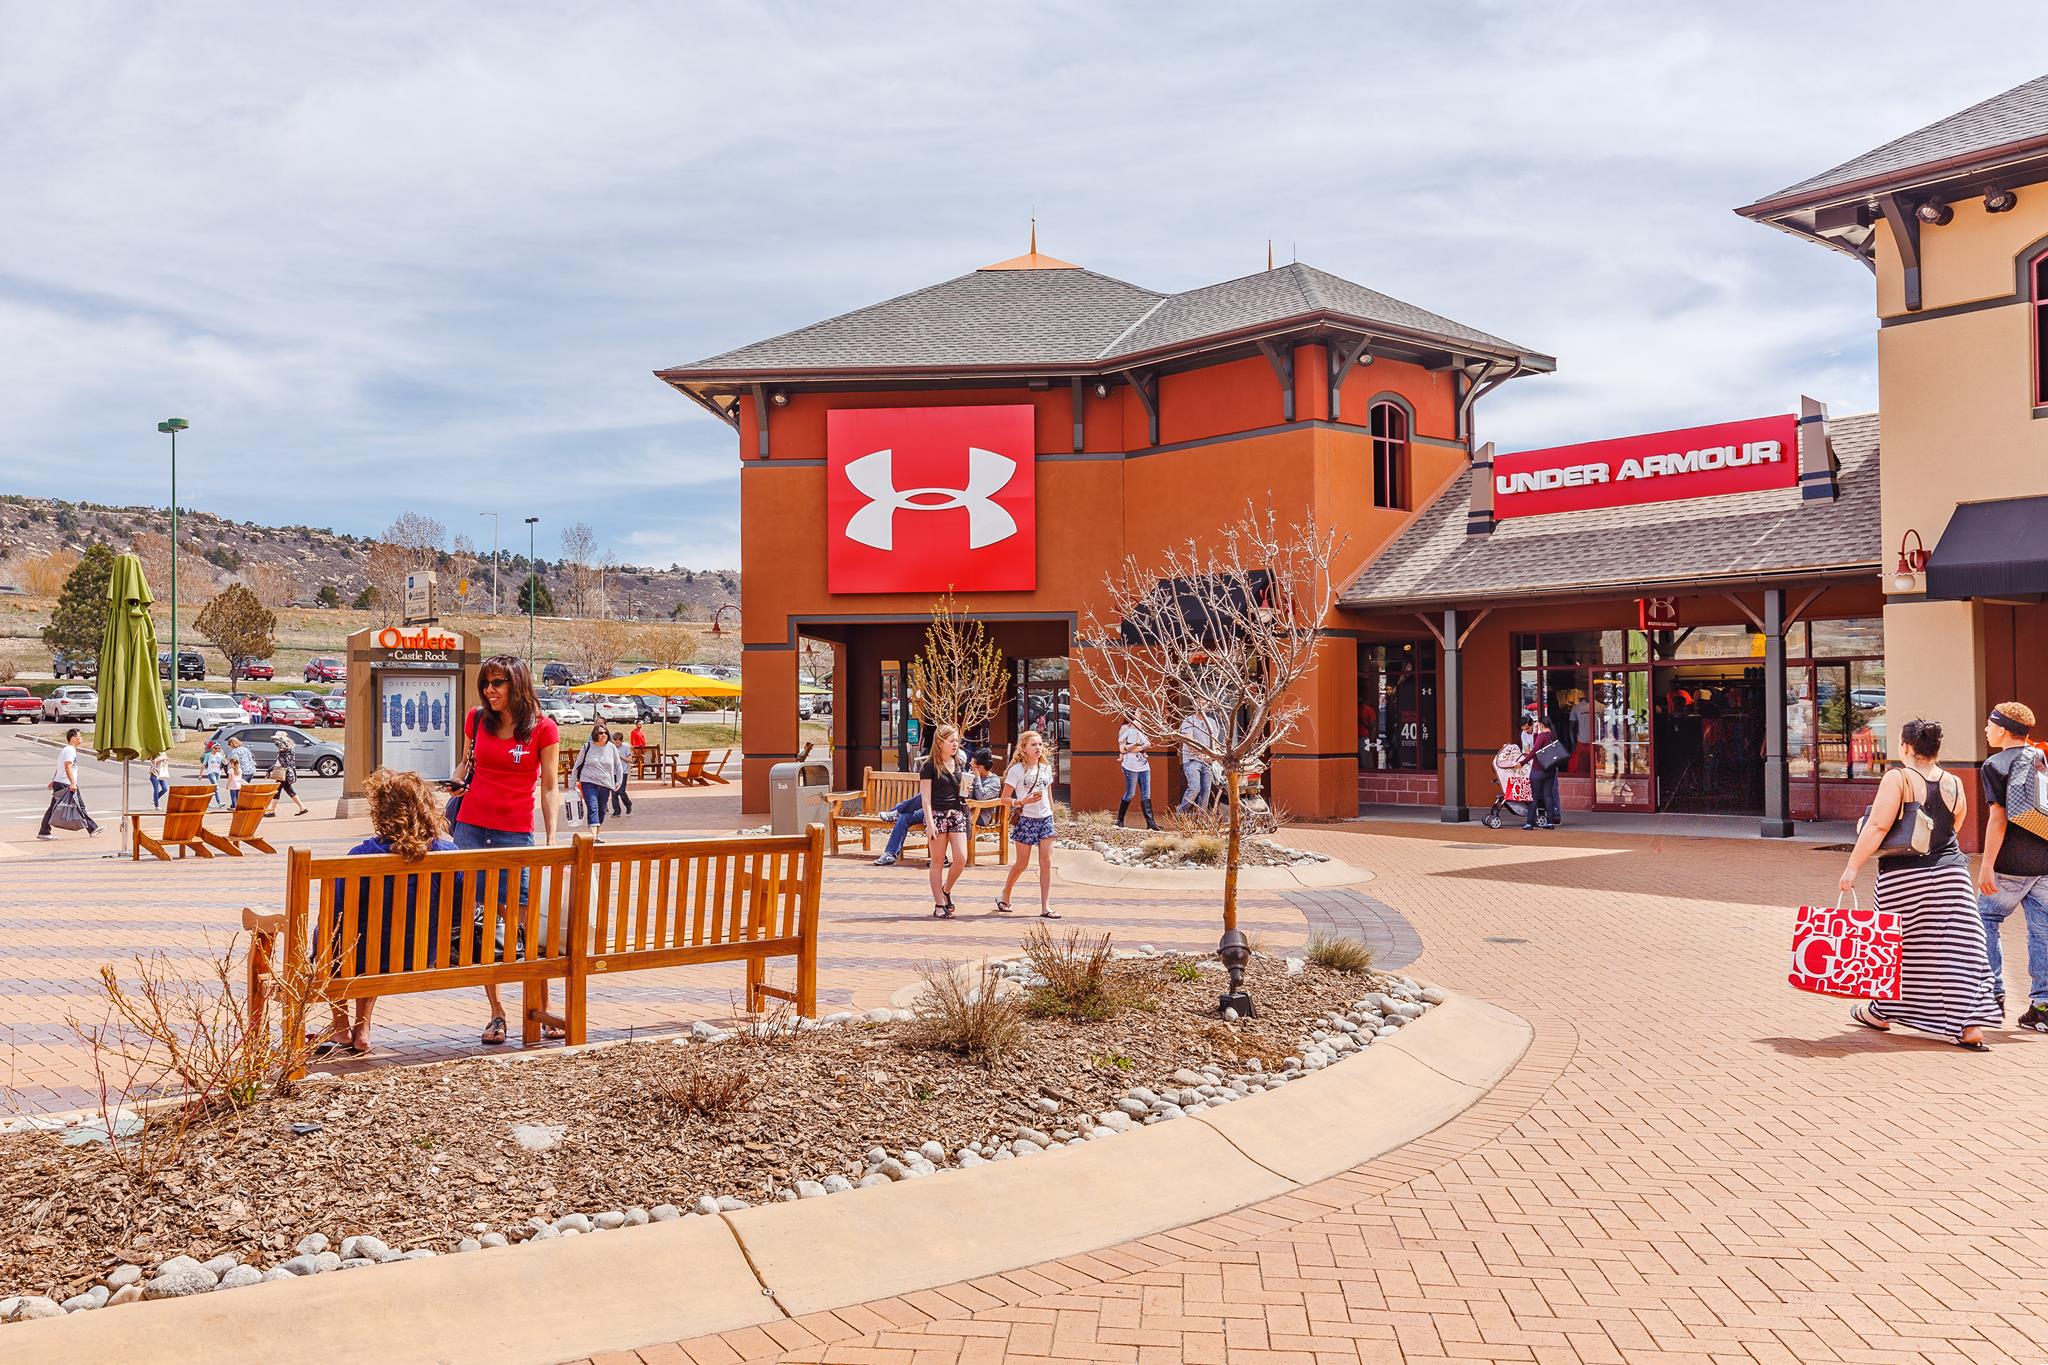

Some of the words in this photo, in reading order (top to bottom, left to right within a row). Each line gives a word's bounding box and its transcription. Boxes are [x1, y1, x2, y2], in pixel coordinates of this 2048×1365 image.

[1496, 462, 1609, 494] UNDER
[1616, 440, 1781, 481] ARMOUR
[379, 627, 456, 650] Outlets
[394, 650, 423, 660] Castle
[425, 651, 448, 661] Rock
[1795, 936, 1893, 979] GUESS
